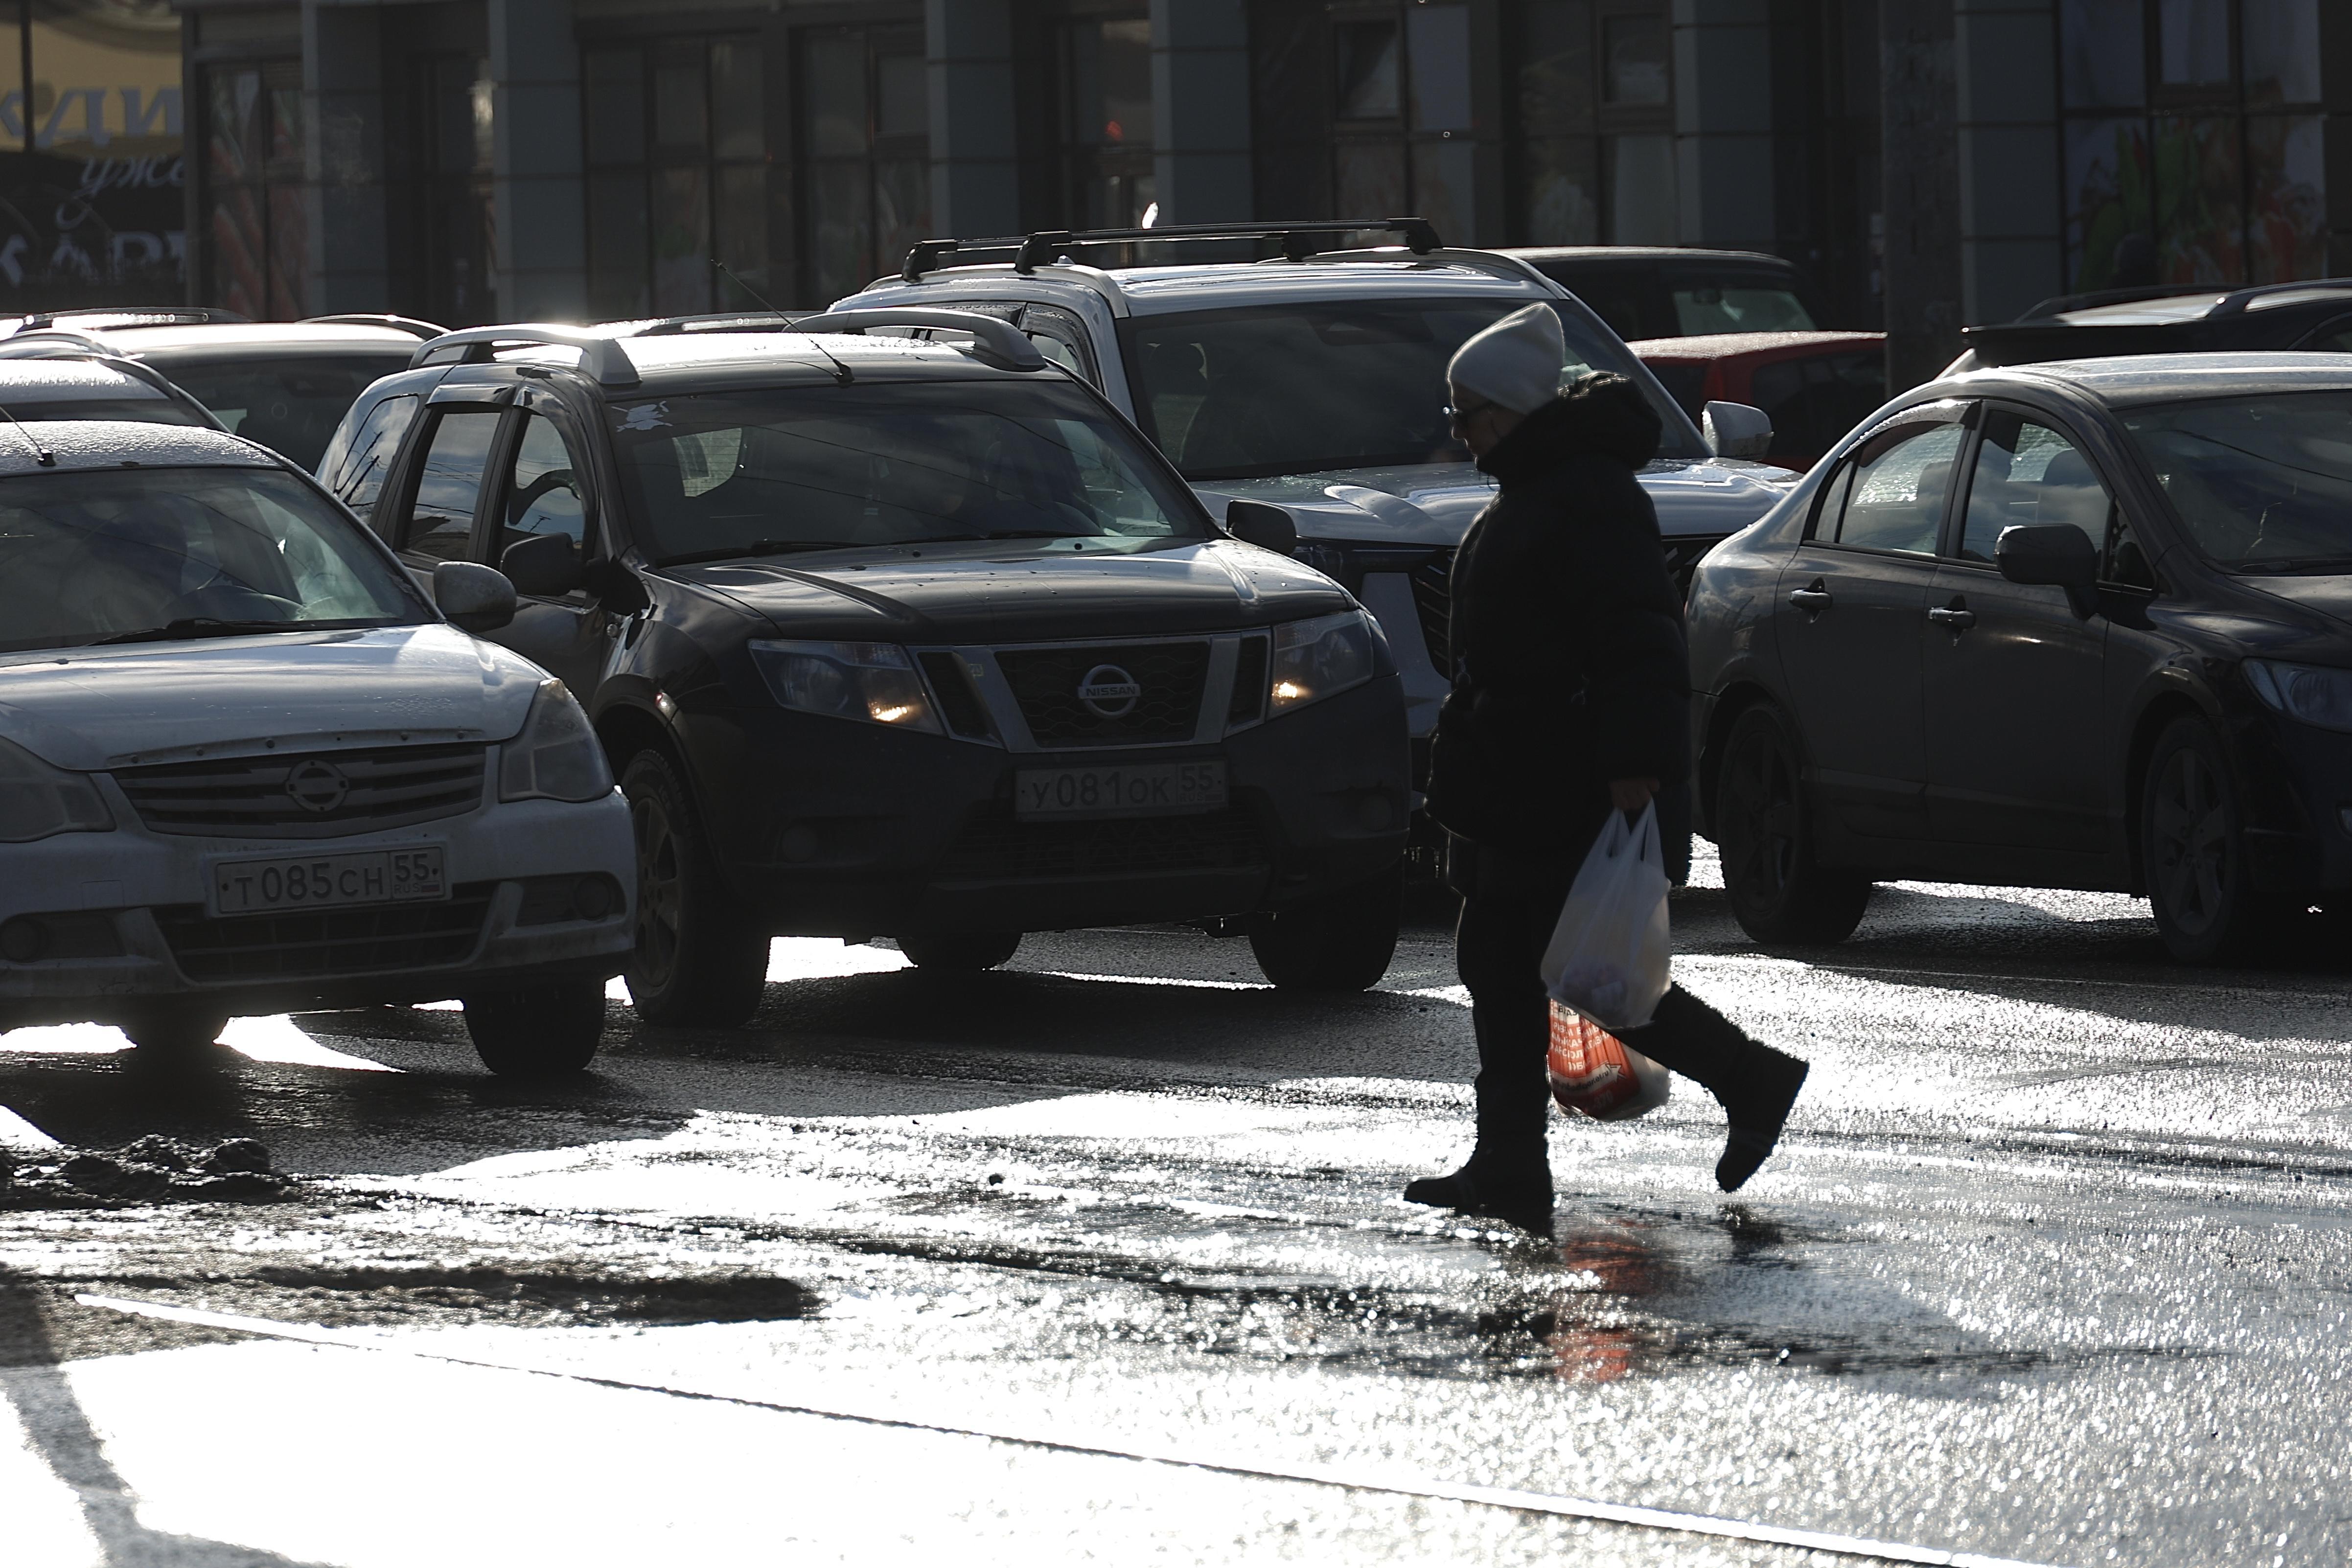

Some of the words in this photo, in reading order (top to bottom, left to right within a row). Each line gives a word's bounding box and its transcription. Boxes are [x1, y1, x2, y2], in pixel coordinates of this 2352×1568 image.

[1086, 686, 1136, 696] NISSAN
[1181, 765, 1214, 791] 55
[1179, 792, 1204, 803] RUS
[394, 853, 430, 882] 55
[394, 882, 420, 894] RUS
